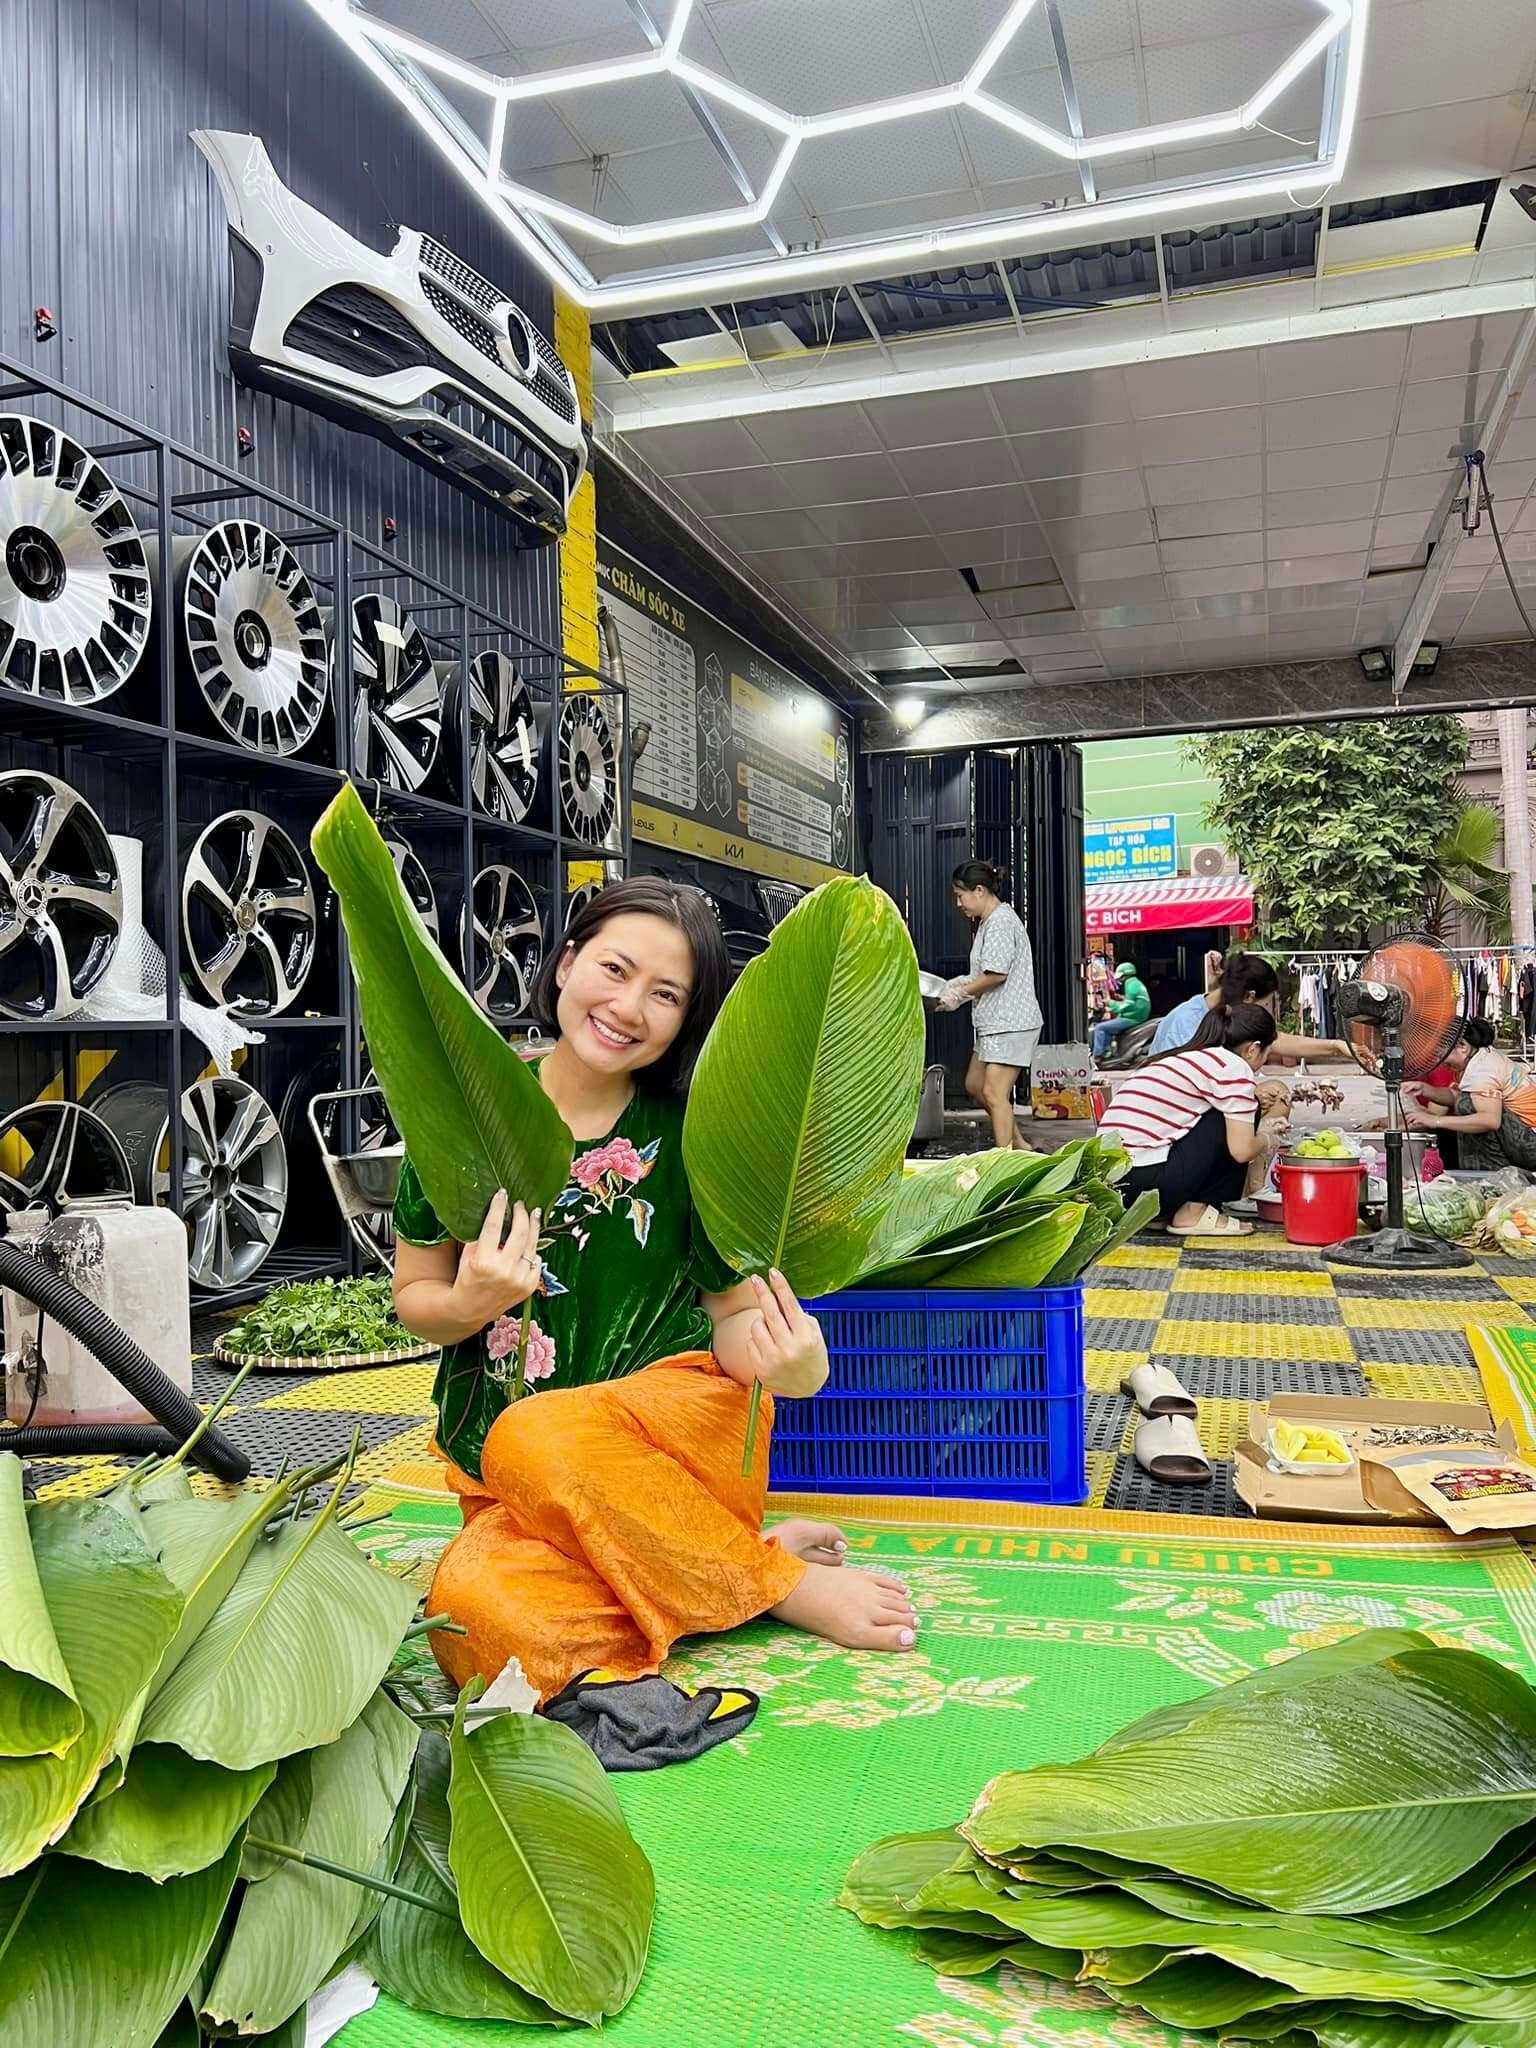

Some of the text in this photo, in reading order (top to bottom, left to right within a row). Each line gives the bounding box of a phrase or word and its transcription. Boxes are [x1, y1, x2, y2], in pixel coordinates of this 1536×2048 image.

[612, 567, 646, 606] CHĂM
[648, 592, 669, 620] SÓC
[671, 607, 686, 632] XE
[633, 818, 655, 831] LEXUS
[1084, 844, 1171, 871] NGỌC BÍCH
[1102, 908, 1142, 925] BÍCH
[904, 1535, 1089, 1560] NHUA
[1119, 1548, 1334, 1577] CHIEU
